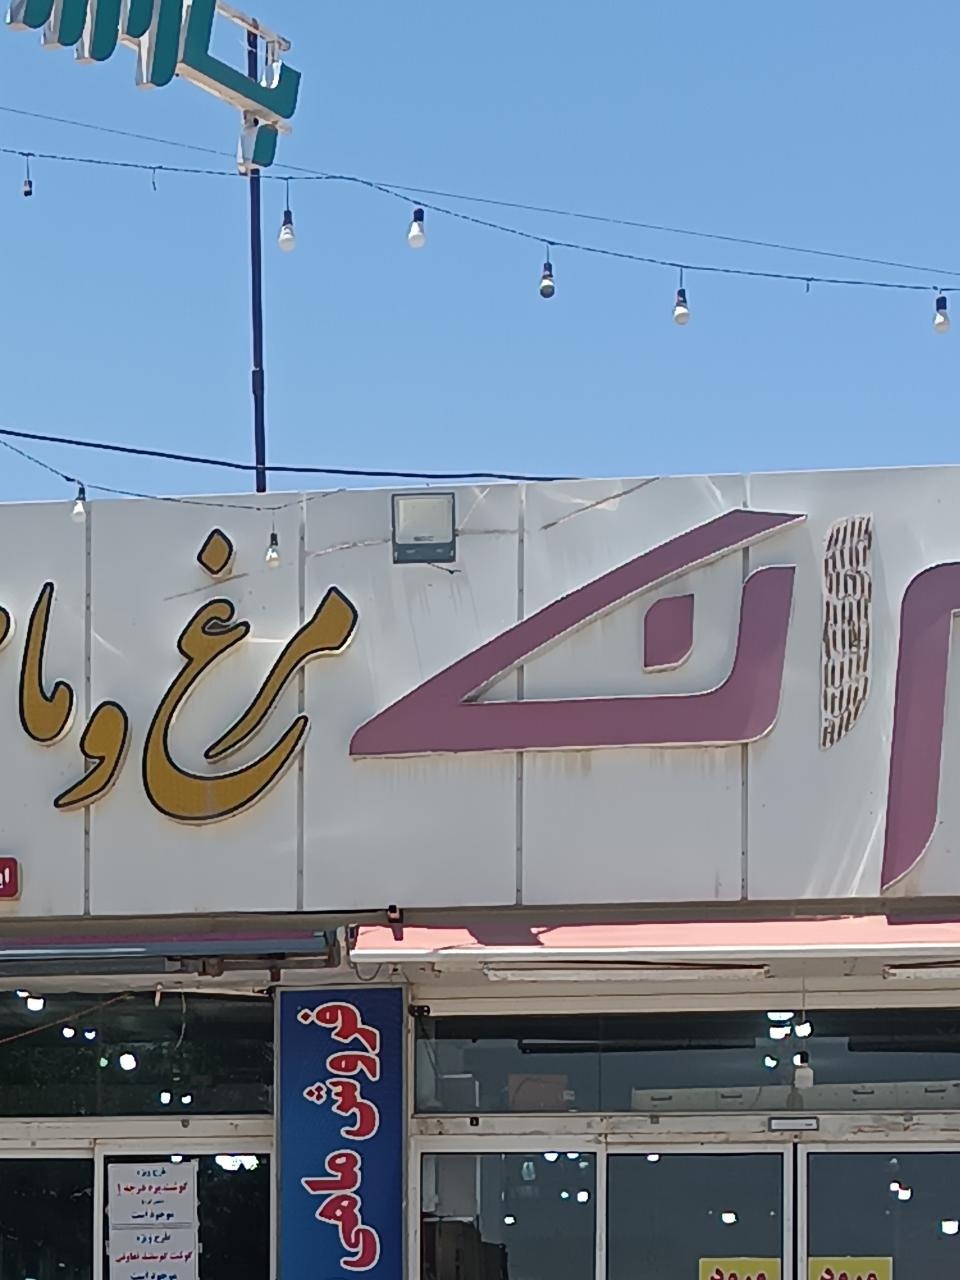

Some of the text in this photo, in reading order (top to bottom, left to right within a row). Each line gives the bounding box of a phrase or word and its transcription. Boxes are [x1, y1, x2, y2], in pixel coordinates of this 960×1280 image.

[141, 525, 360, 827] مرغ
[53, 701, 131, 811] و
[297, 1001, 381, 1141] فروش
[301, 1149, 381, 1271] ماهی
